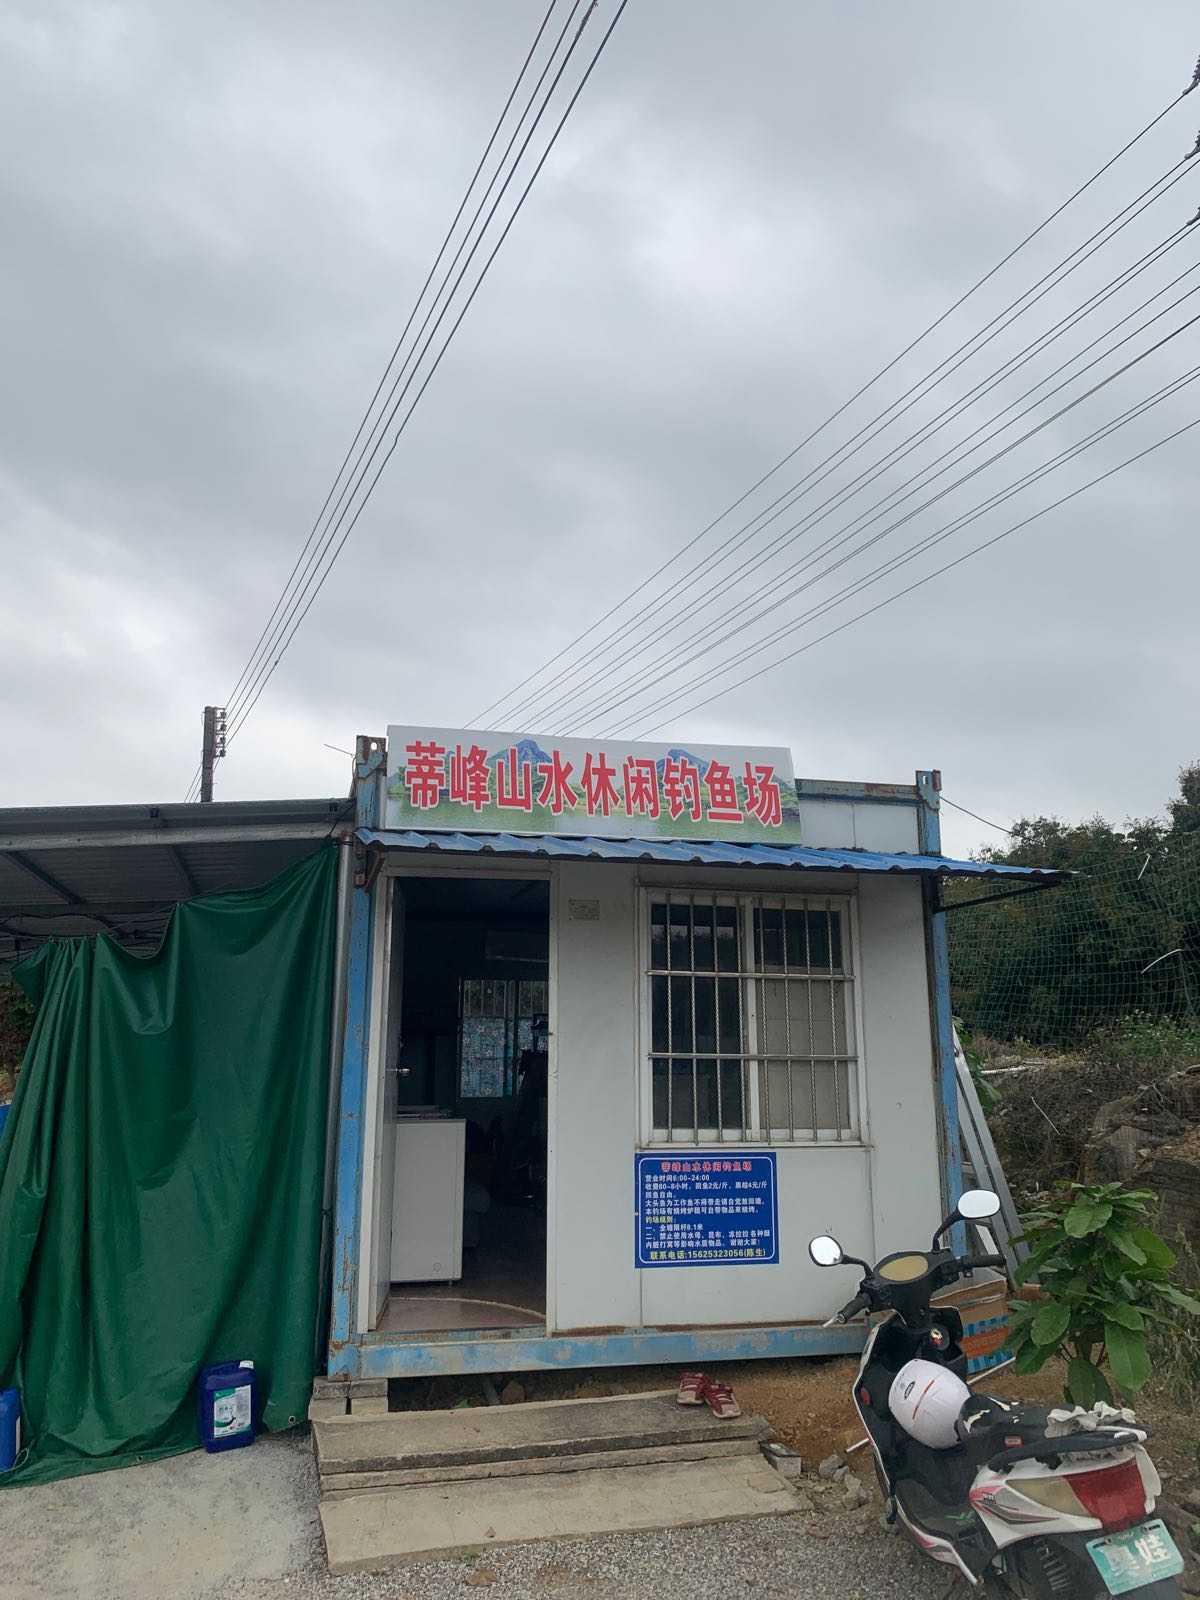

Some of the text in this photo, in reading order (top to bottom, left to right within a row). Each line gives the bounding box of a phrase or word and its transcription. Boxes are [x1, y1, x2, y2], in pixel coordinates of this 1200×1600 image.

[405, 740, 782, 827] 蒂峰山水休闲钓鱼场
